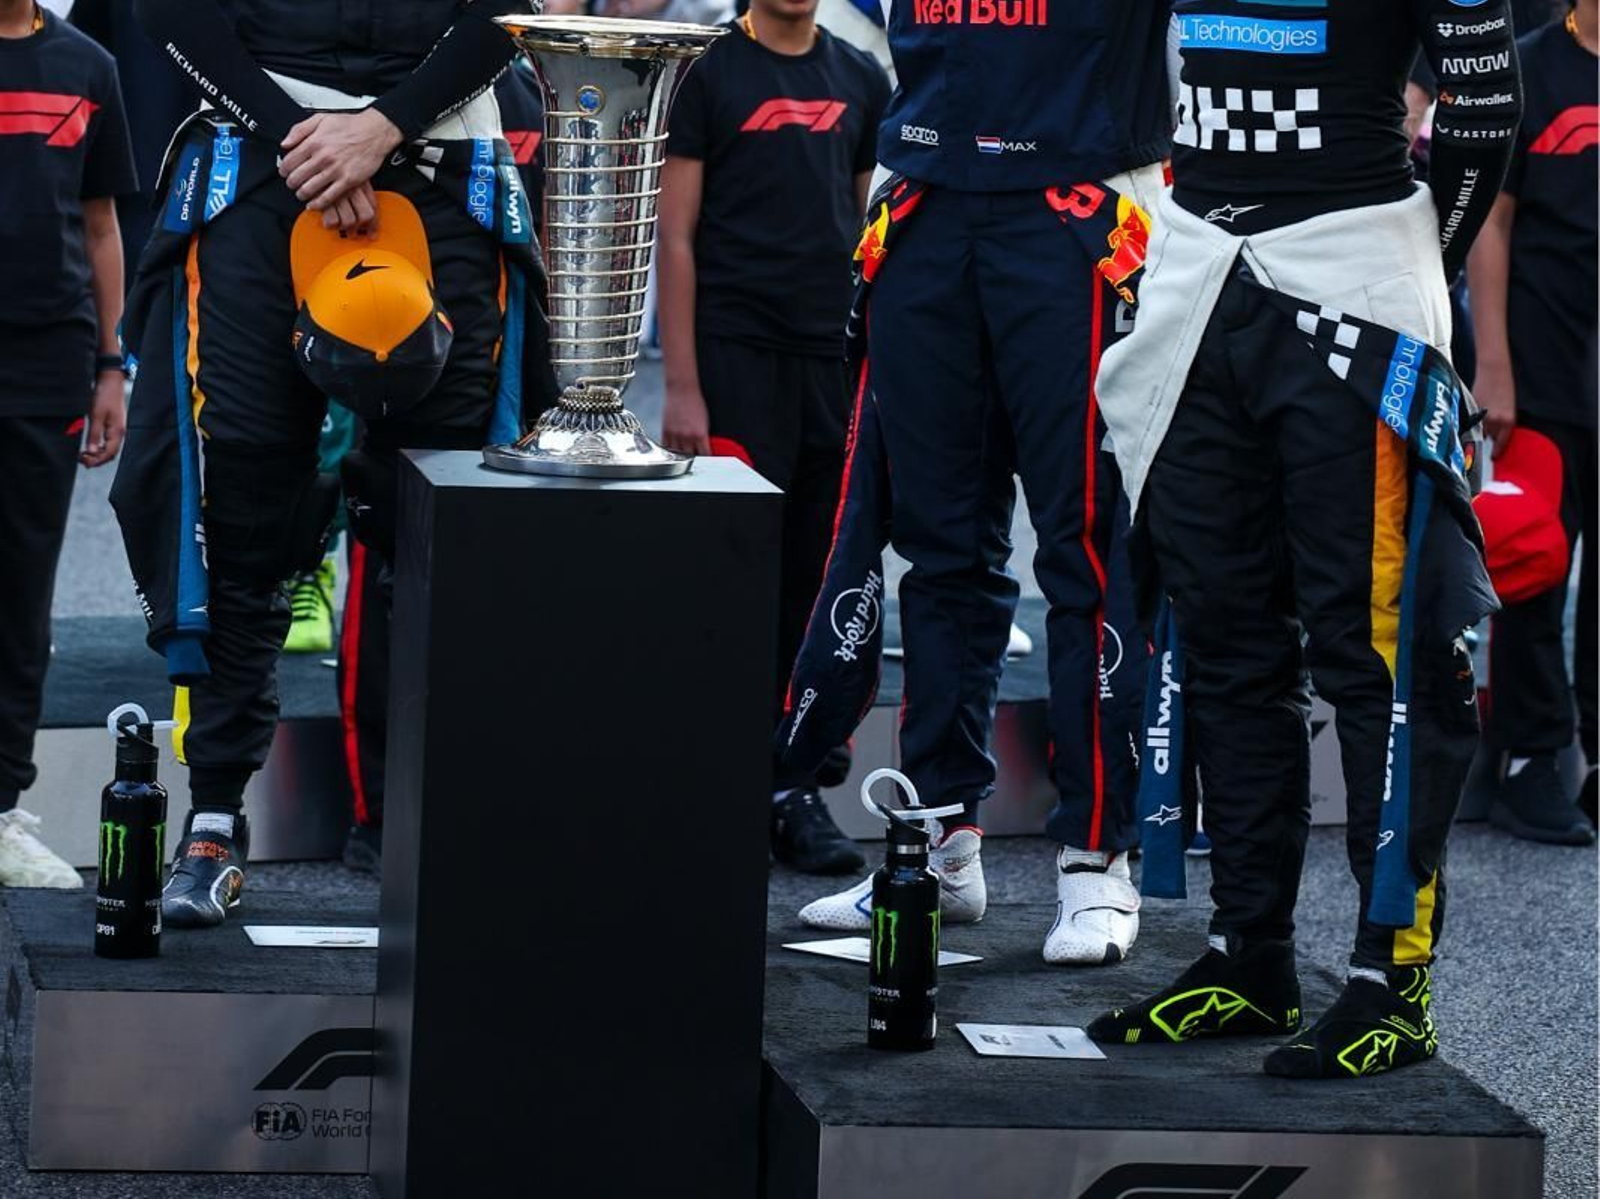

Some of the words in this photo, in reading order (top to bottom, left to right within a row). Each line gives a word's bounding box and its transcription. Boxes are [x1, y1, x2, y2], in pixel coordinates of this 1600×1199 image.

[1193, 18, 1318, 51] Technologies
[1456, 17, 1506, 36] Dropbox
[165, 42, 218, 97] RICHARD
[219, 94, 259, 132] MILLE
[1455, 93, 1513, 106] Airwallex
[1001, 141, 1037, 151] MAX
[184, 157, 200, 201] WORLD
[1456, 167, 1479, 207] MILLE
[180, 202, 191, 221] DP
[856, 570, 882, 620] Hard
[833, 619, 866, 662] Rock
[1146, 650, 1181, 775] allwyn
[312, 1109, 339, 1122] FIA
[312, 1125, 362, 1138] World
